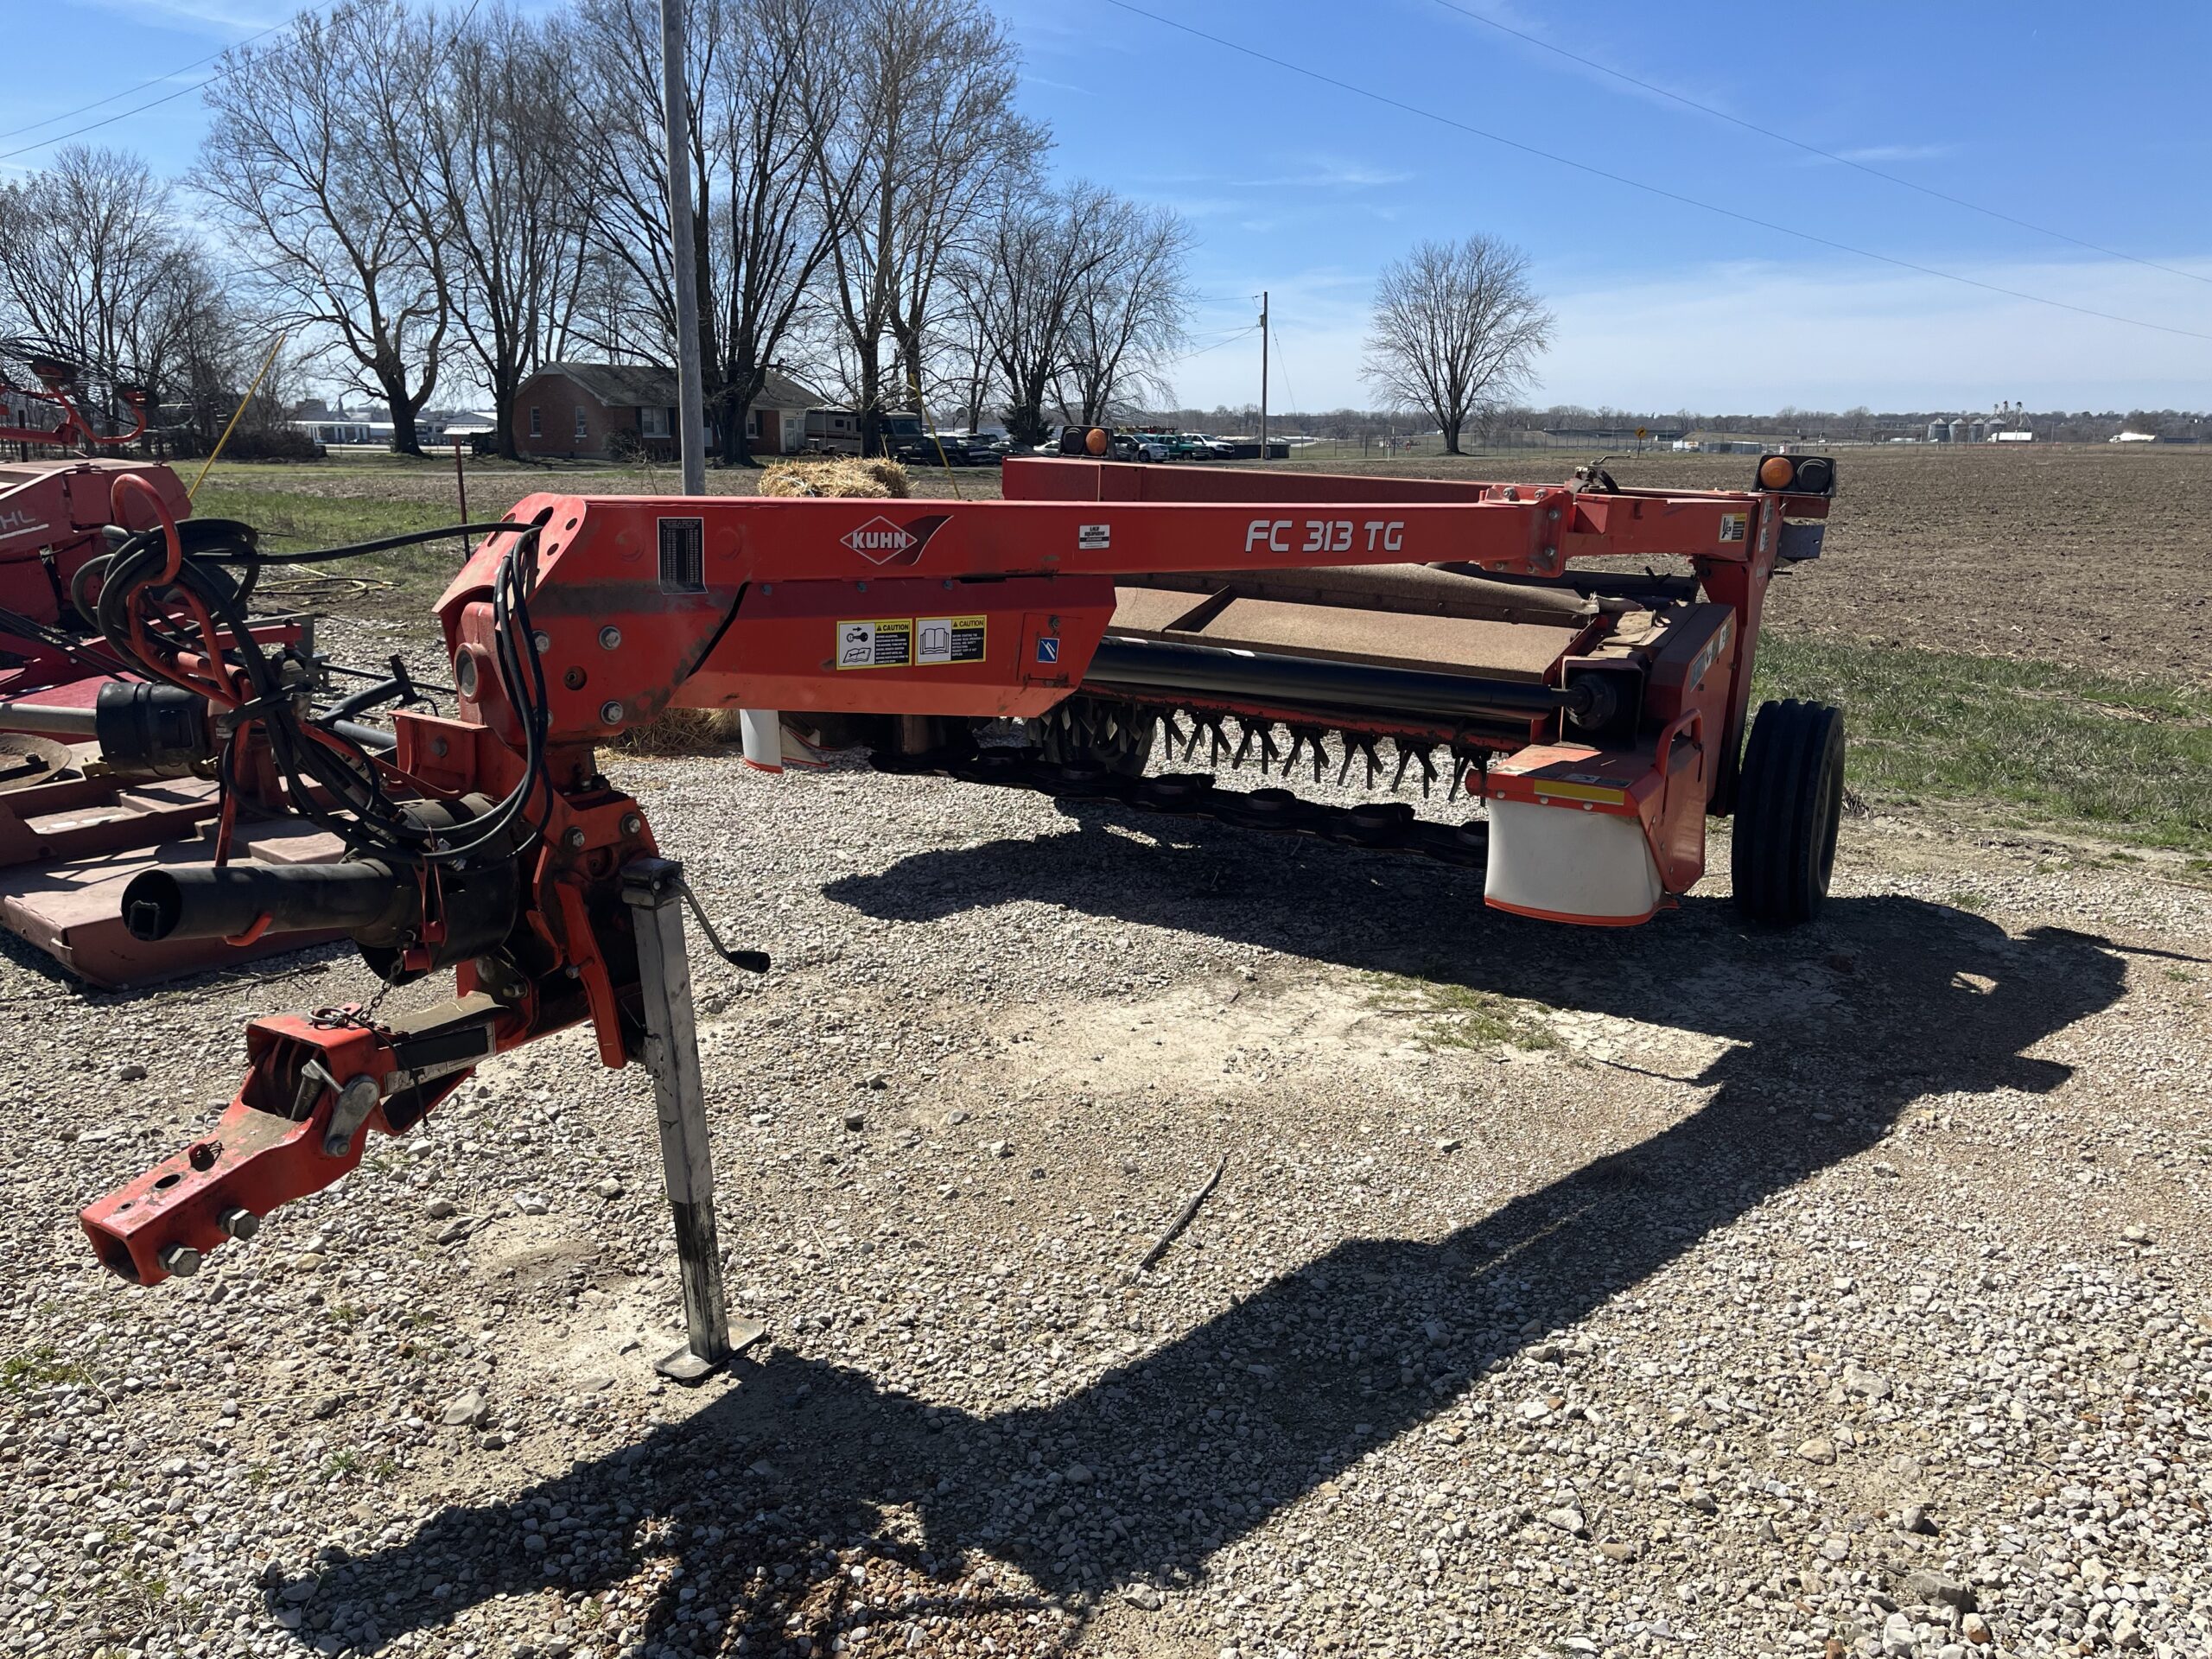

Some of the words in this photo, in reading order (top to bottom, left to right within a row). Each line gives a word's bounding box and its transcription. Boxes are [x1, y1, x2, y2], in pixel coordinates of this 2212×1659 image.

[852, 531, 906, 550] KUHN
[1244, 519, 1294, 552] FC
[1302, 520, 1354, 552] 313
[1363, 521, 1405, 551] TG
